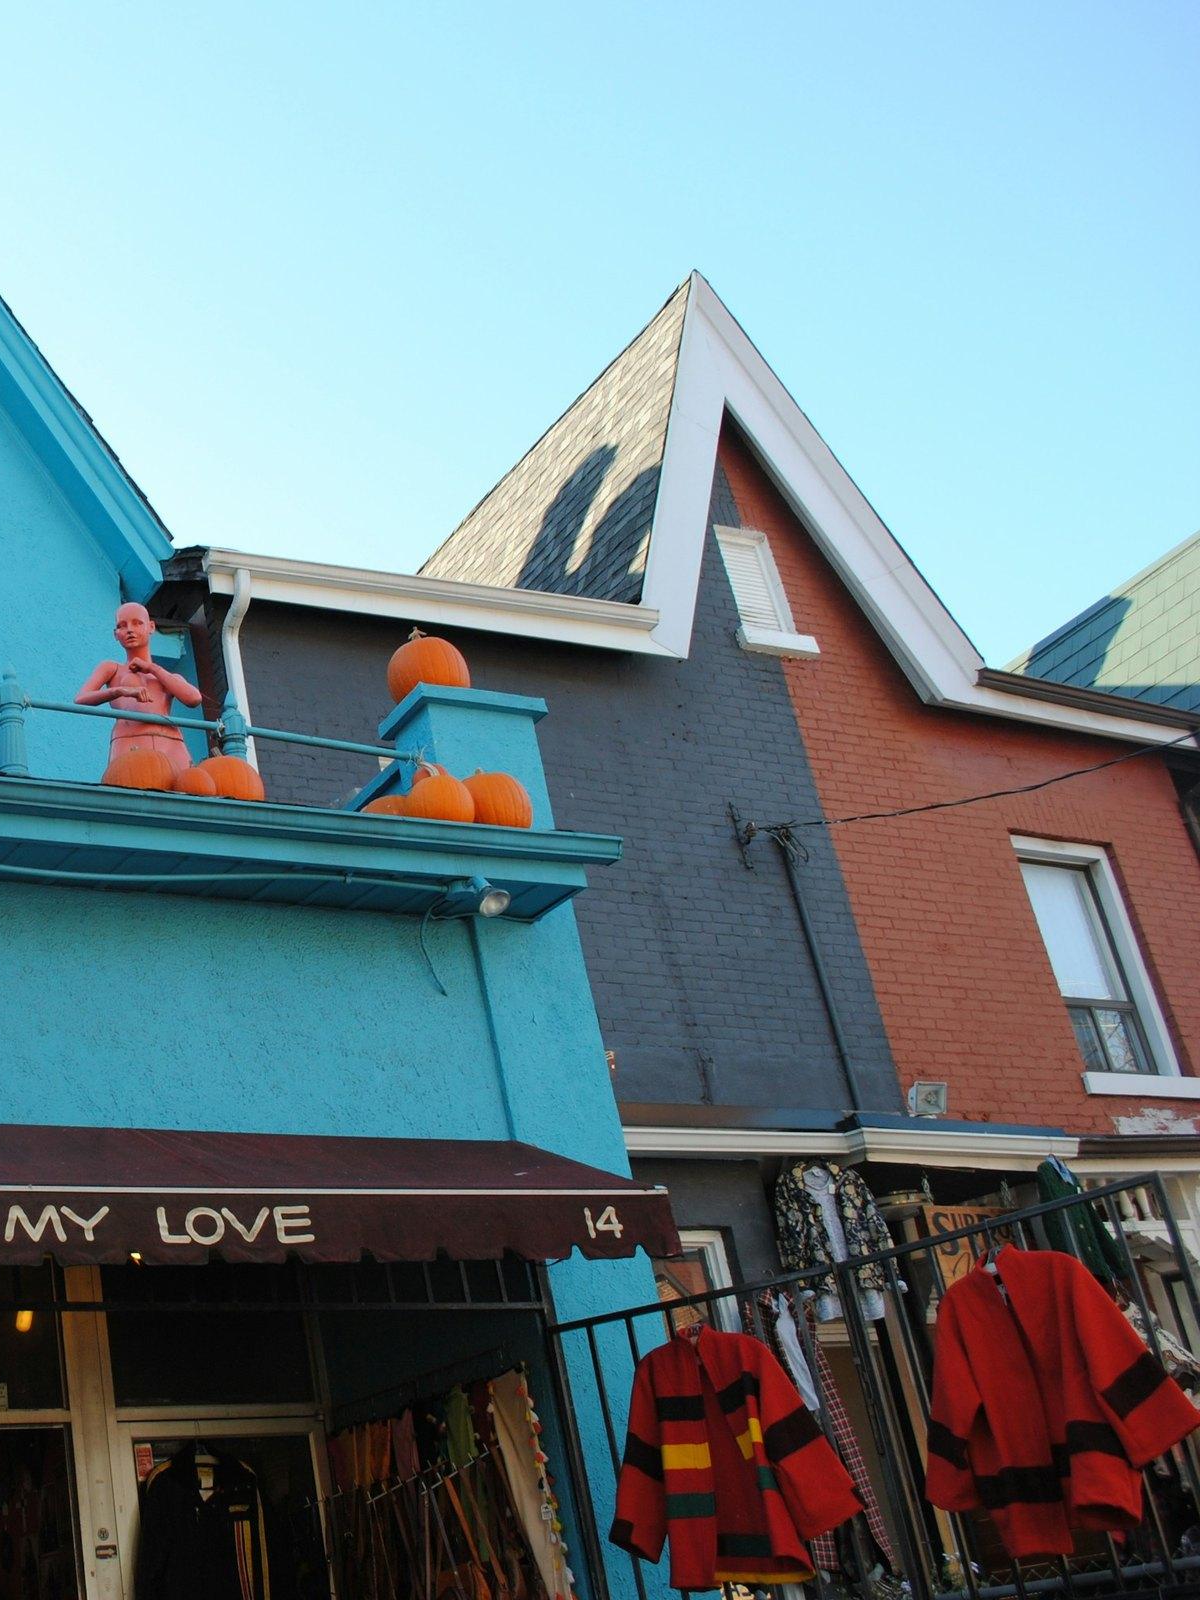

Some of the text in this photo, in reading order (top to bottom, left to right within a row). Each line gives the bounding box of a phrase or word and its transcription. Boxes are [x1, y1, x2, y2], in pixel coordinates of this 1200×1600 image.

[4, 1204, 110, 1242] MY
[156, 1206, 316, 1246] LOVE
[583, 1205, 624, 1239] 14
